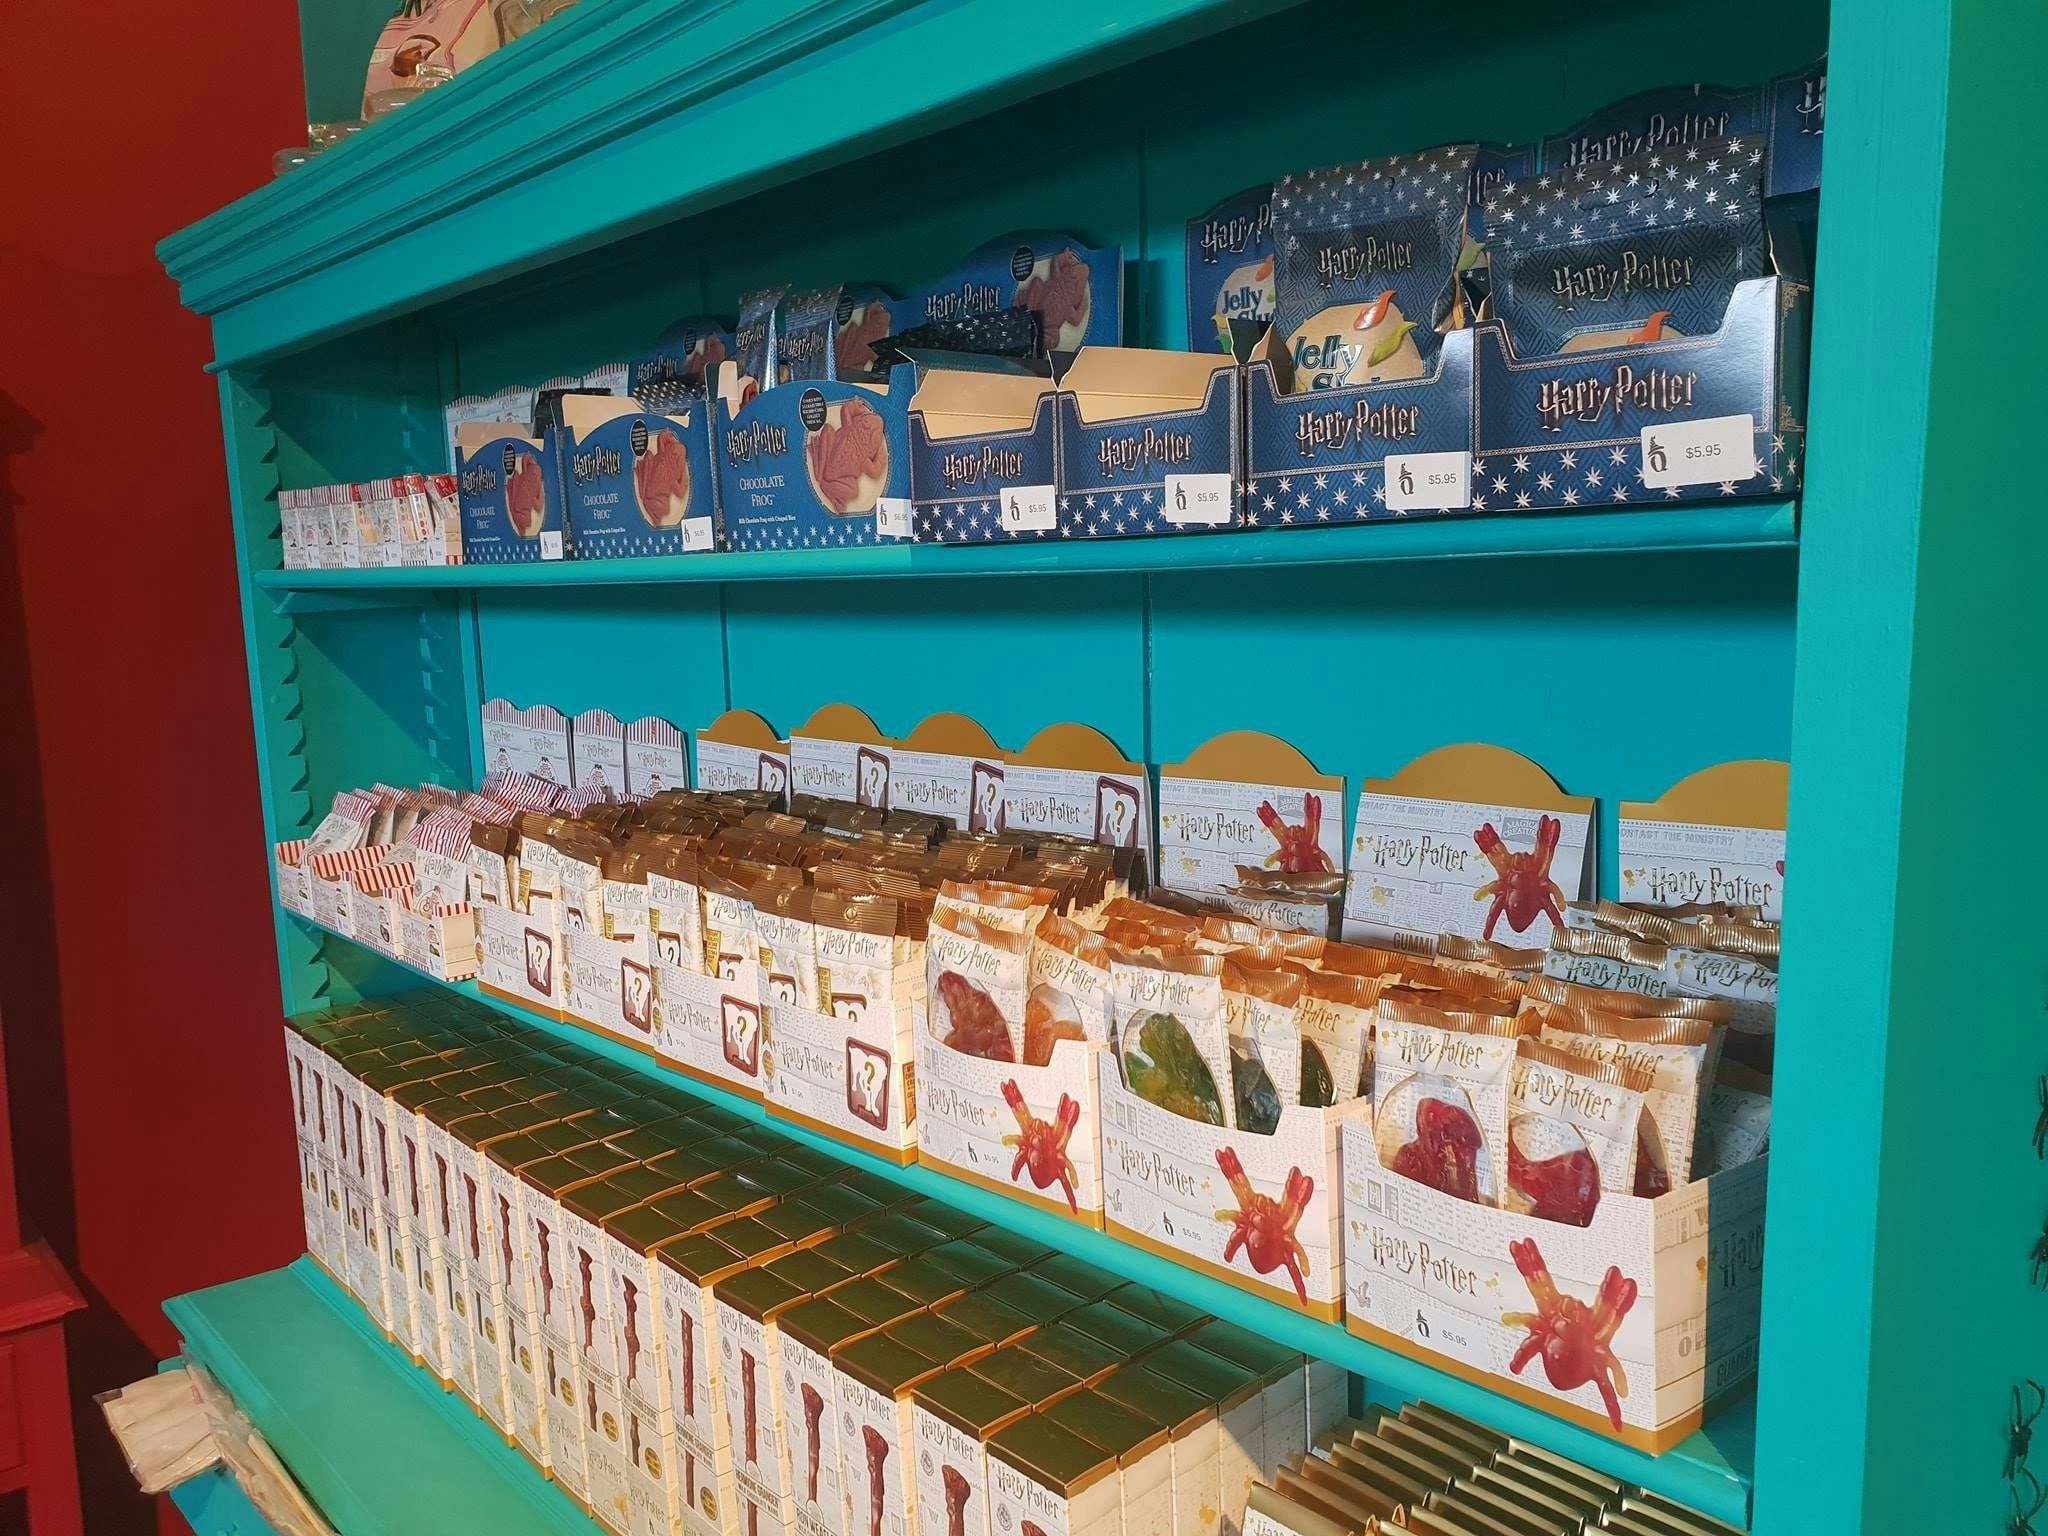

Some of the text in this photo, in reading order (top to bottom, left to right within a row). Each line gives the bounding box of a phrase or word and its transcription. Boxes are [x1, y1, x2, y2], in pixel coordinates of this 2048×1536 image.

[1201, 215, 1255, 264] Harry
[1317, 236, 1413, 288] Harry Potter
[1551, 250, 1694, 312] Harry Potter
[1222, 287, 1264, 313] Jelly
[1294, 335, 1364, 378] Jelly
[1536, 365, 1697, 432] Harry Potter
[727, 420, 787, 468] Harry Potter
[1295, 399, 1420, 458] Harry Potter
[573, 446, 622, 488] Harry Potter
[943, 445, 1024, 491] Harry Potter
[1097, 427, 1193, 479] Harry Potter
[1685, 443, 1722, 459] $5.95
[739, 474, 785, 491] CHOCOLATE
[1196, 491, 1220, 504] $5.95
[1428, 472, 1457, 486] $5.95
[583, 494, 620, 507] CHOCOLATE
[1028, 503, 1048, 514] $5.95
[802, 762, 847, 789] Harry Potter
[905, 779, 959, 808] Harry Potter
[1020, 796, 1081, 828] Harry Potter
[1177, 812, 1255, 848] Harry Potter
[1372, 834, 1469, 877] Harry Potter
[1647, 866, 1777, 907] Harry Potter
[822, 929, 879, 960] Harry Potter
[937, 935, 1001, 977] Harry Potter
[1036, 948, 1098, 994] Harry Potter
[1129, 968, 1162, 1002] Harry
[1158, 972, 1195, 1009] Potter
[1565, 956, 1668, 997] Harry Potter
[1300, 999, 1342, 1034] Potter
[782, 1041, 836, 1080] Harry Potter
[1399, 1029, 1485, 1072] Harry Potter
[927, 1080, 951, 1115] Harry
[950, 1088, 987, 1127] Potter
[1511, 1064, 1616, 1122] Harry Potter
[1119, 1140, 1197, 1199] Harry Potter
[1368, 1225, 1479, 1298] Harry Potter
[720, 1304, 761, 1344] Harry Potter
[1441, 1328, 1468, 1347] $5.95
[783, 1335, 826, 1379] Harry Potter
[841, 1376, 891, 1422] Harry Potter
[920, 1413, 976, 1463] Harry Potter
[997, 1462, 1060, 1520] Harry Potter
